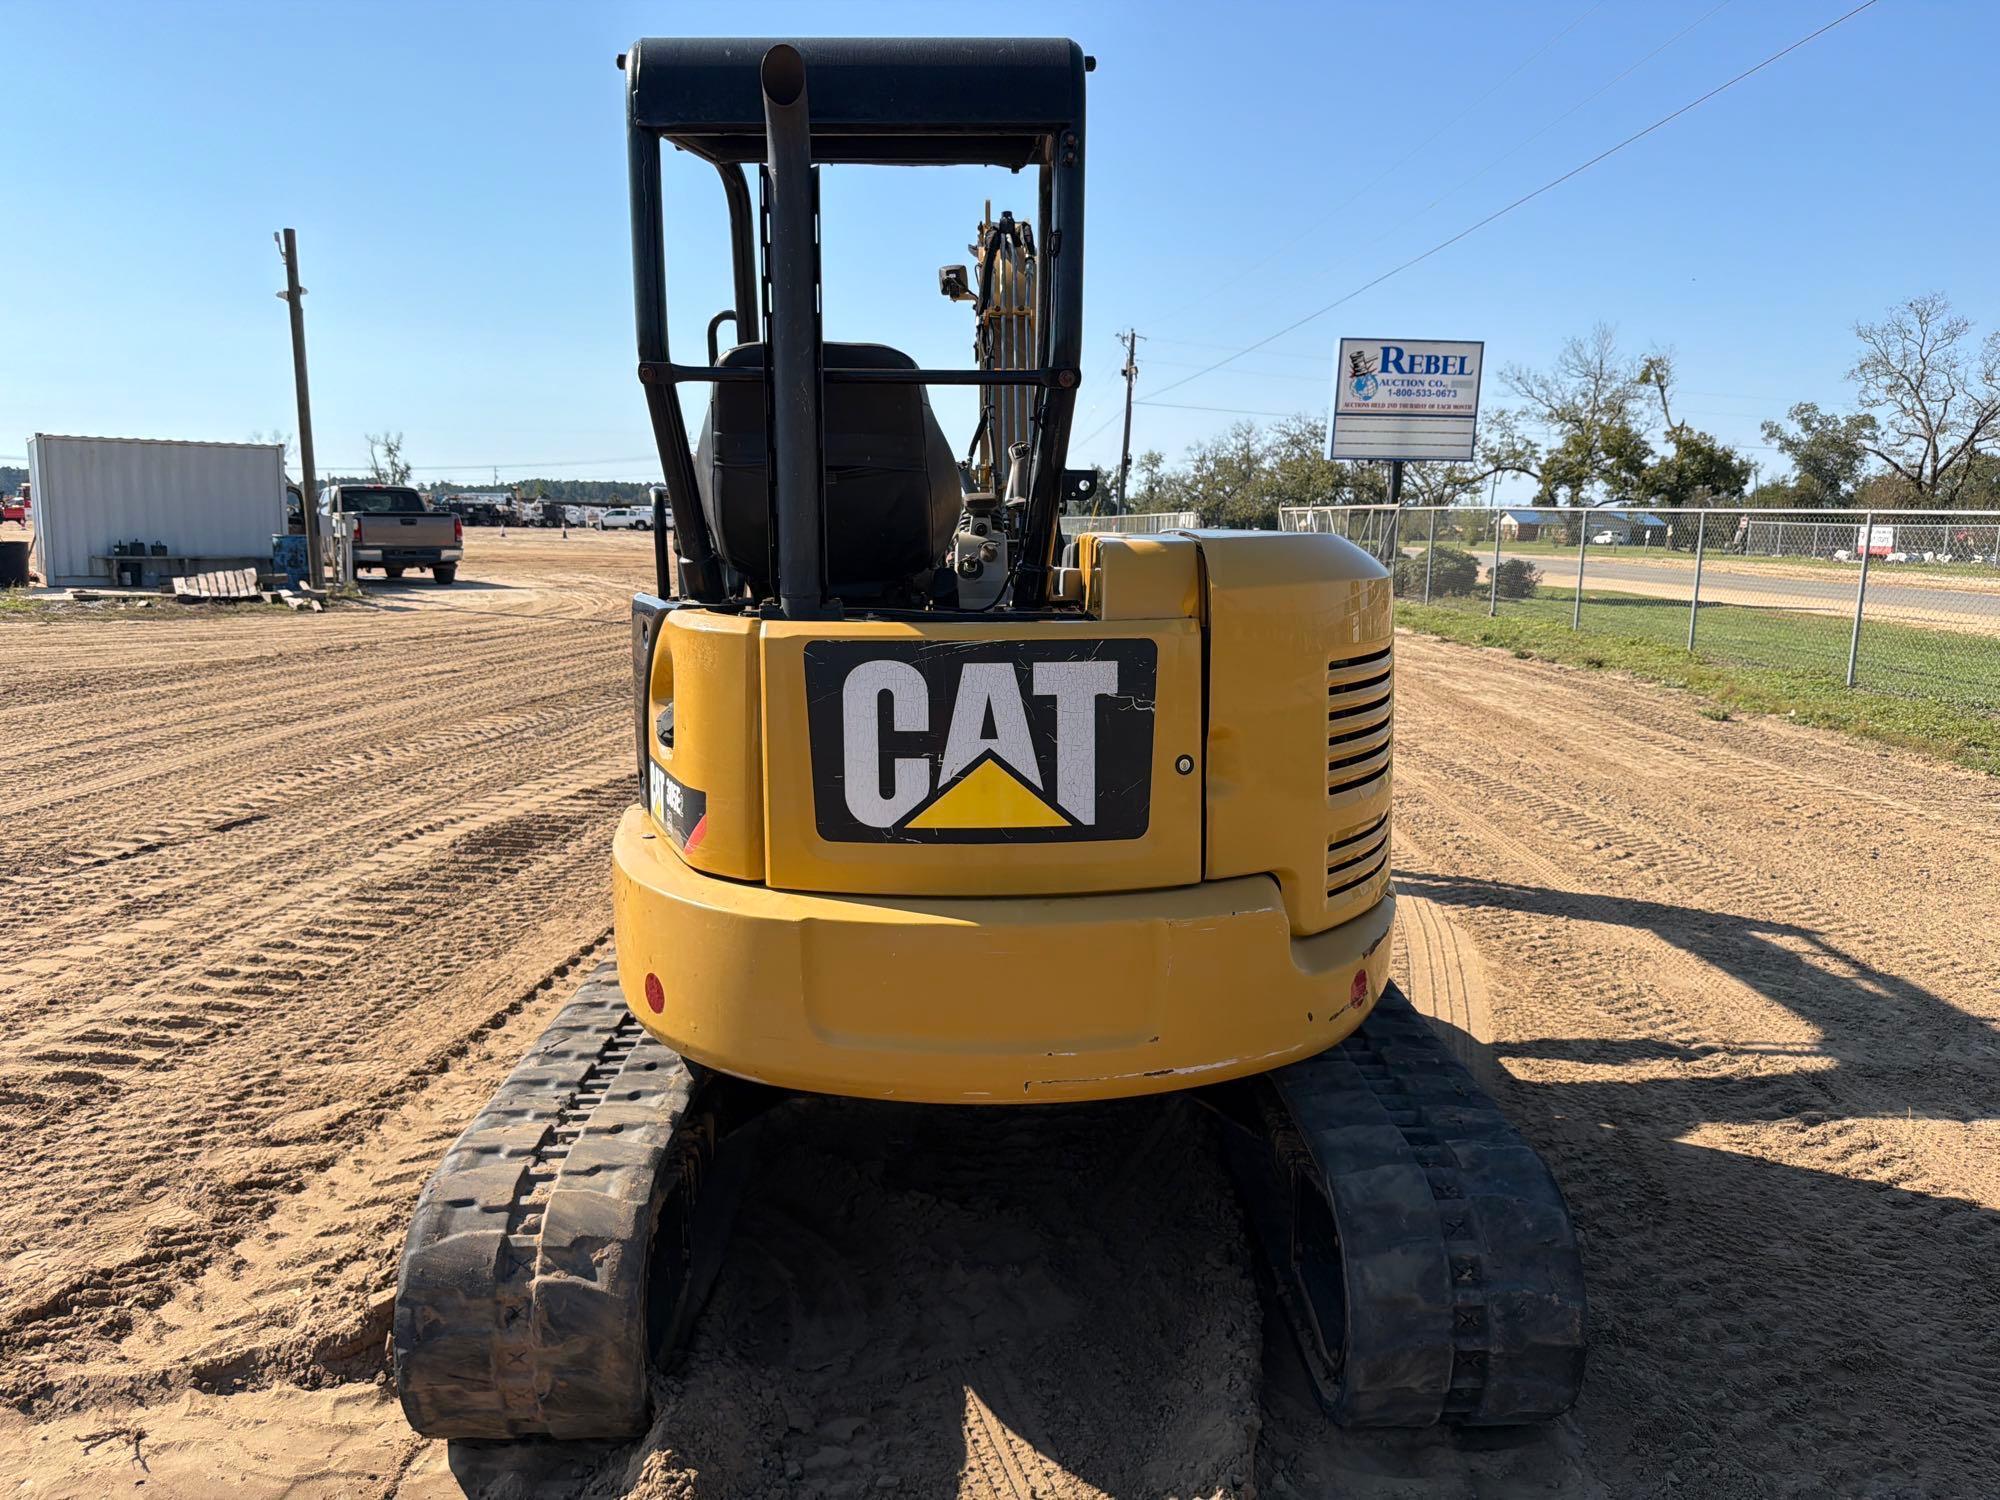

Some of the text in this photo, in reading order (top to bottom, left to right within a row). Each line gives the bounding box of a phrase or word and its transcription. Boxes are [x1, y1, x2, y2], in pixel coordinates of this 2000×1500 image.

[1378, 346, 1474, 376] REBEL
[1379, 379, 1425, 388] AUCTION
[1388, 389, 1458, 398] 1-800-533-0673
[843, 660, 1118, 828] CAT
